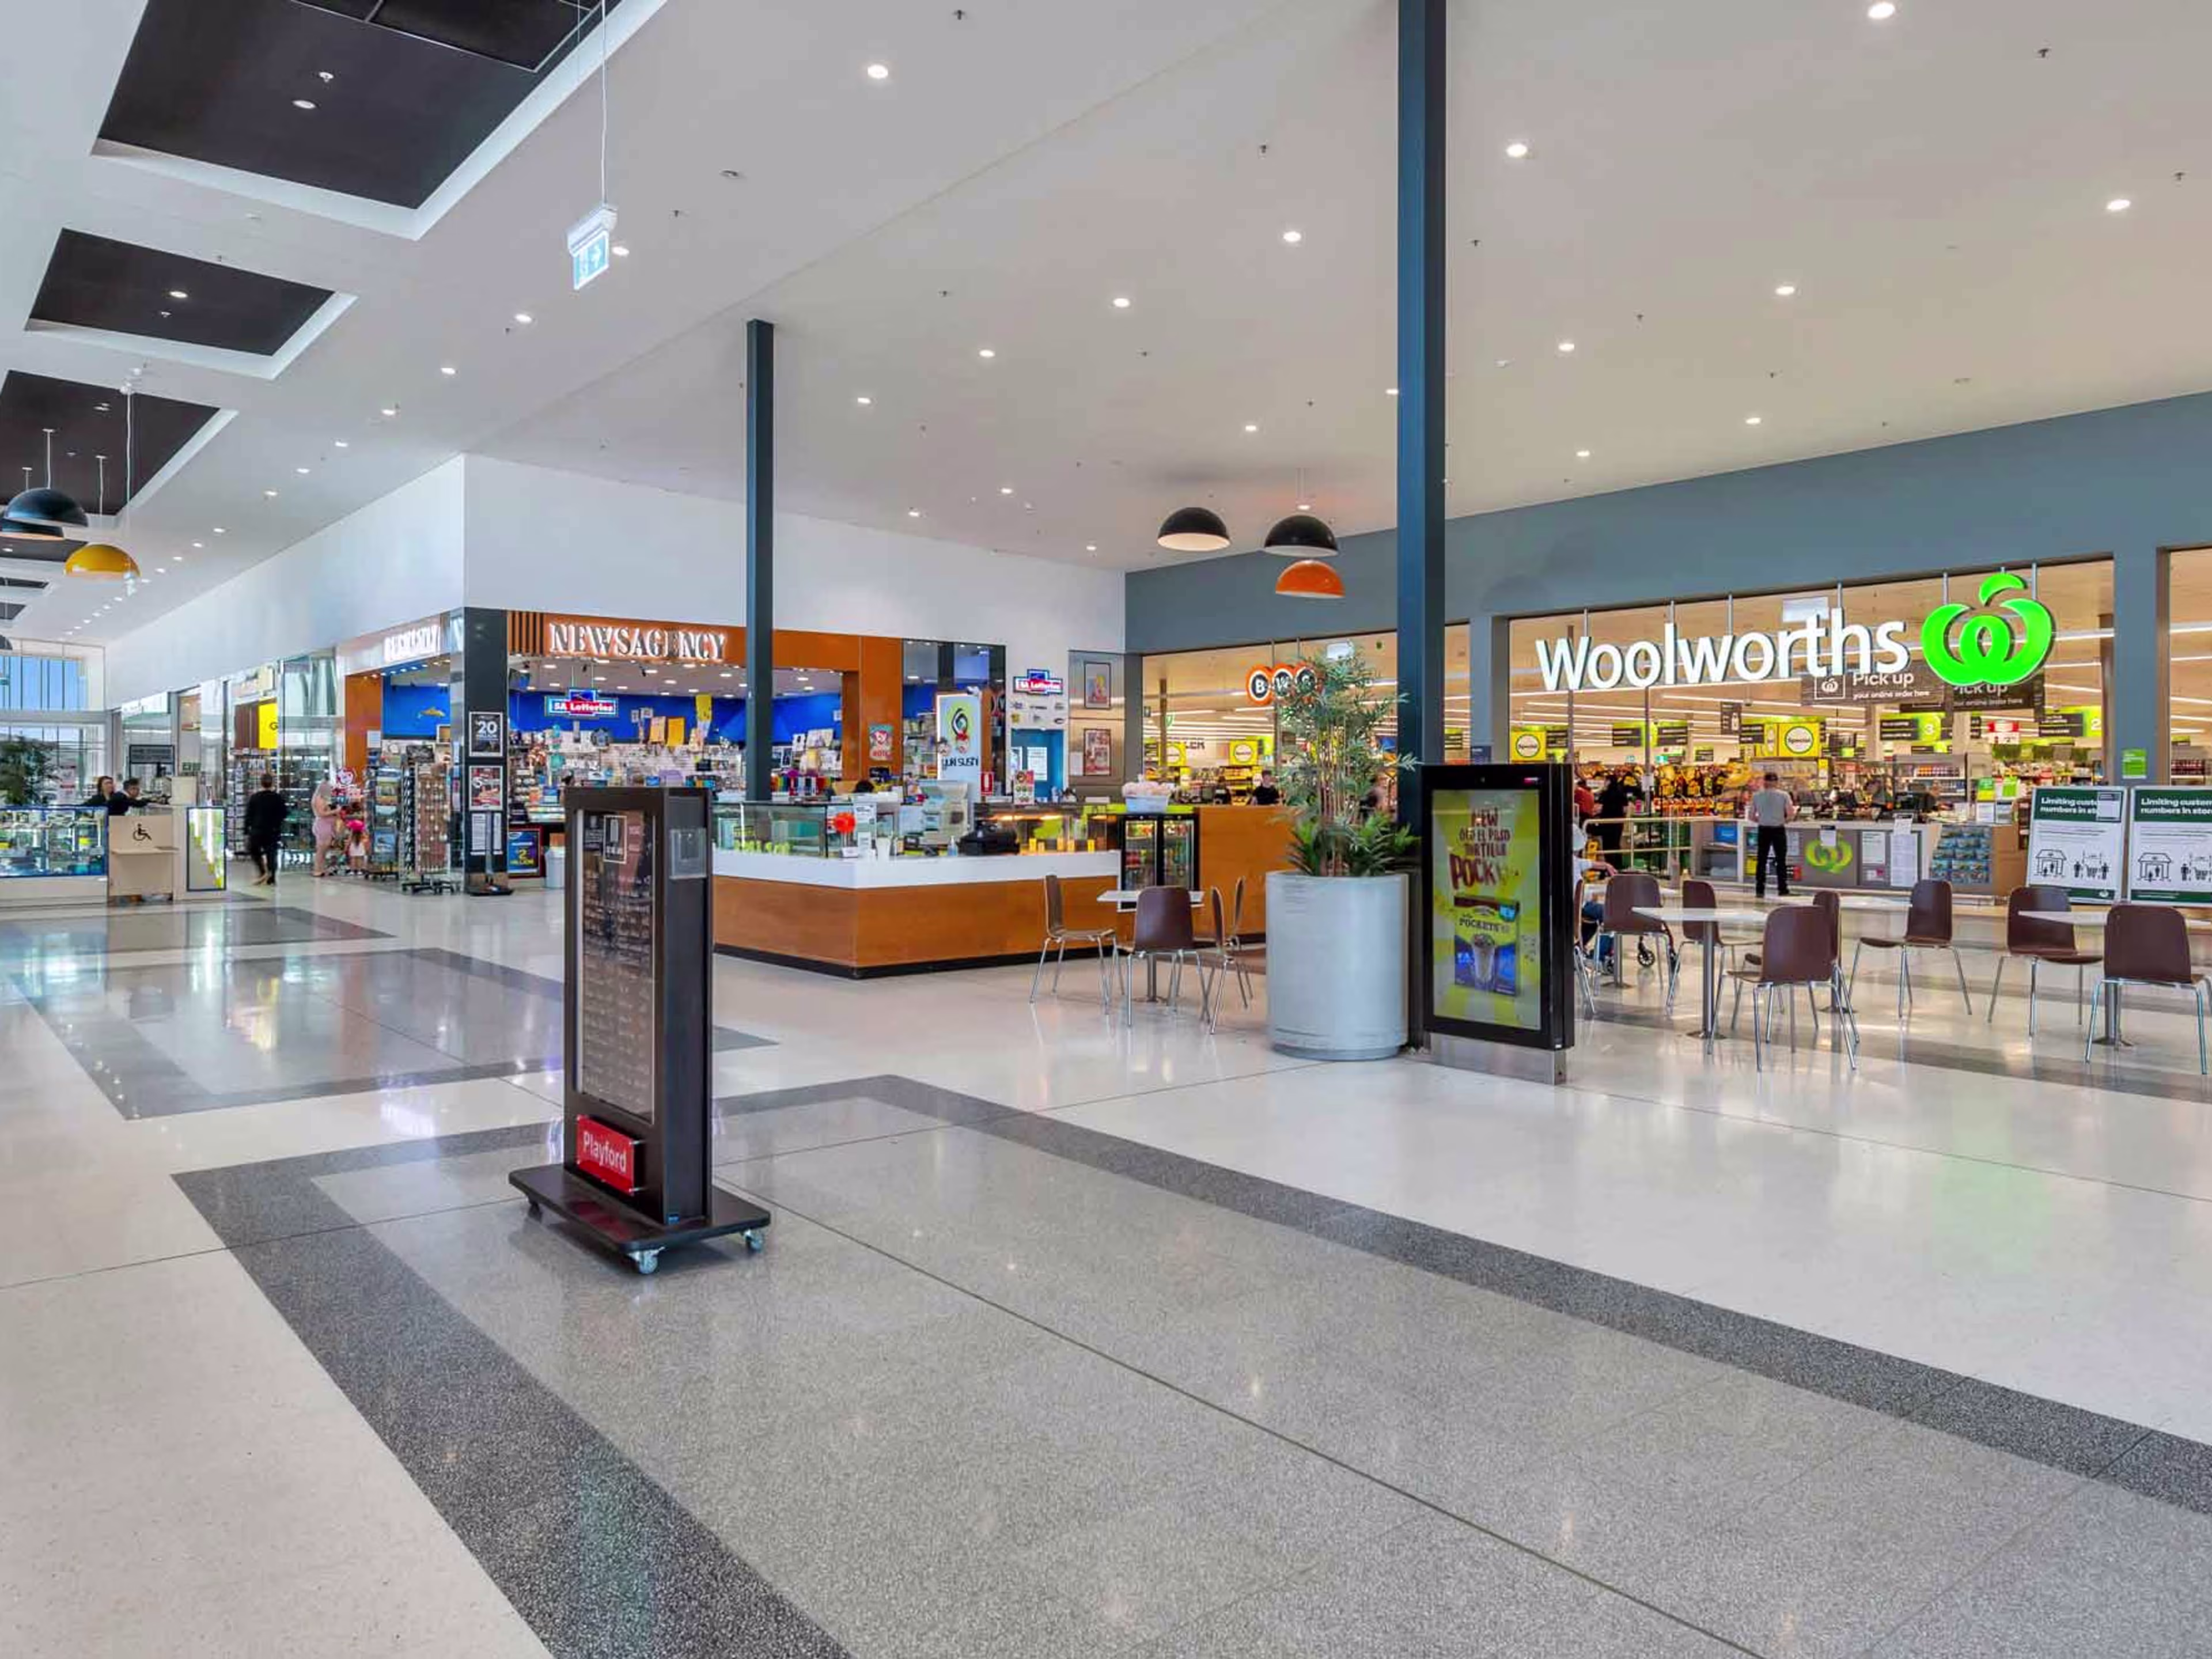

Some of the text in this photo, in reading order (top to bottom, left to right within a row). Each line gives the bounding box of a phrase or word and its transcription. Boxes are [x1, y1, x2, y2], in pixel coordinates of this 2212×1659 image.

[549, 622, 726, 661] NEWSAGENCY
[1535, 607, 1911, 691] Woolworths
[1853, 672, 1914, 688] Pick up
[554, 702, 613, 712] SA Lotteries
[2041, 797, 2075, 806] Limiting
[2141, 797, 2179, 807] Limiting
[2040, 806, 2077, 814] numbers
[583, 1130, 627, 1174] Playford
